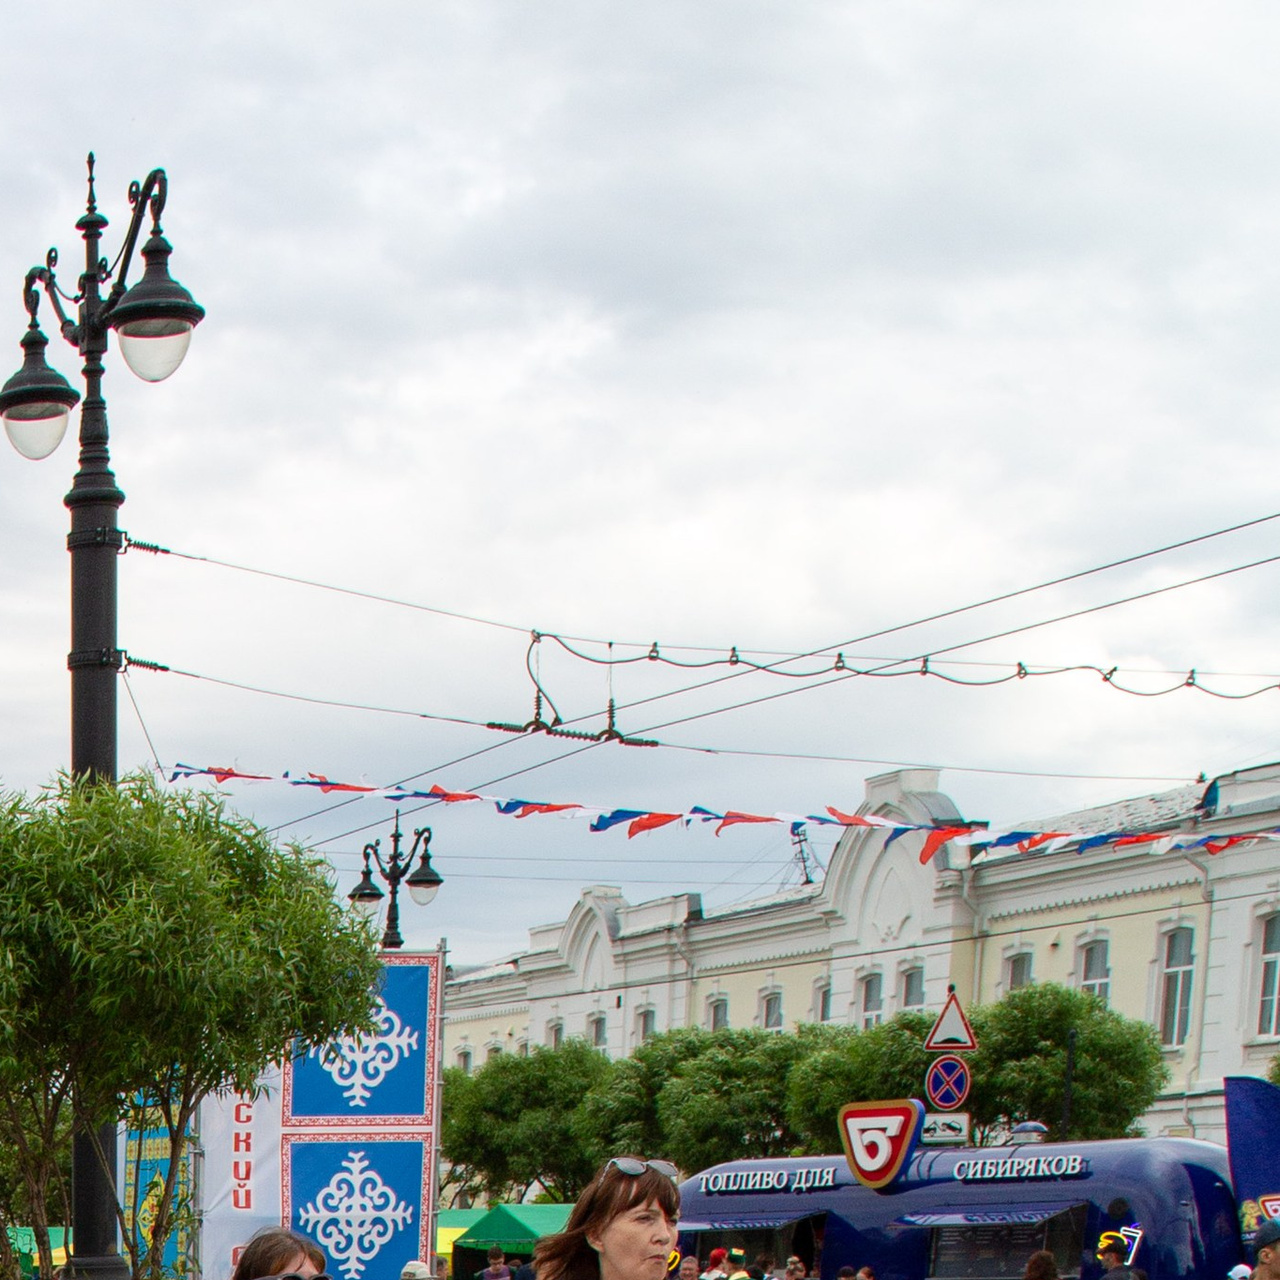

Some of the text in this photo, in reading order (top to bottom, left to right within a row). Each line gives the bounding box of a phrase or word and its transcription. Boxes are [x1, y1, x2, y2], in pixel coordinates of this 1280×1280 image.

[233, 1085, 253, 1209] СКИЙ
[699, 1154, 1083, 1193] ТОПЛИВО ДЛЯ СИБИРЯКОВ
